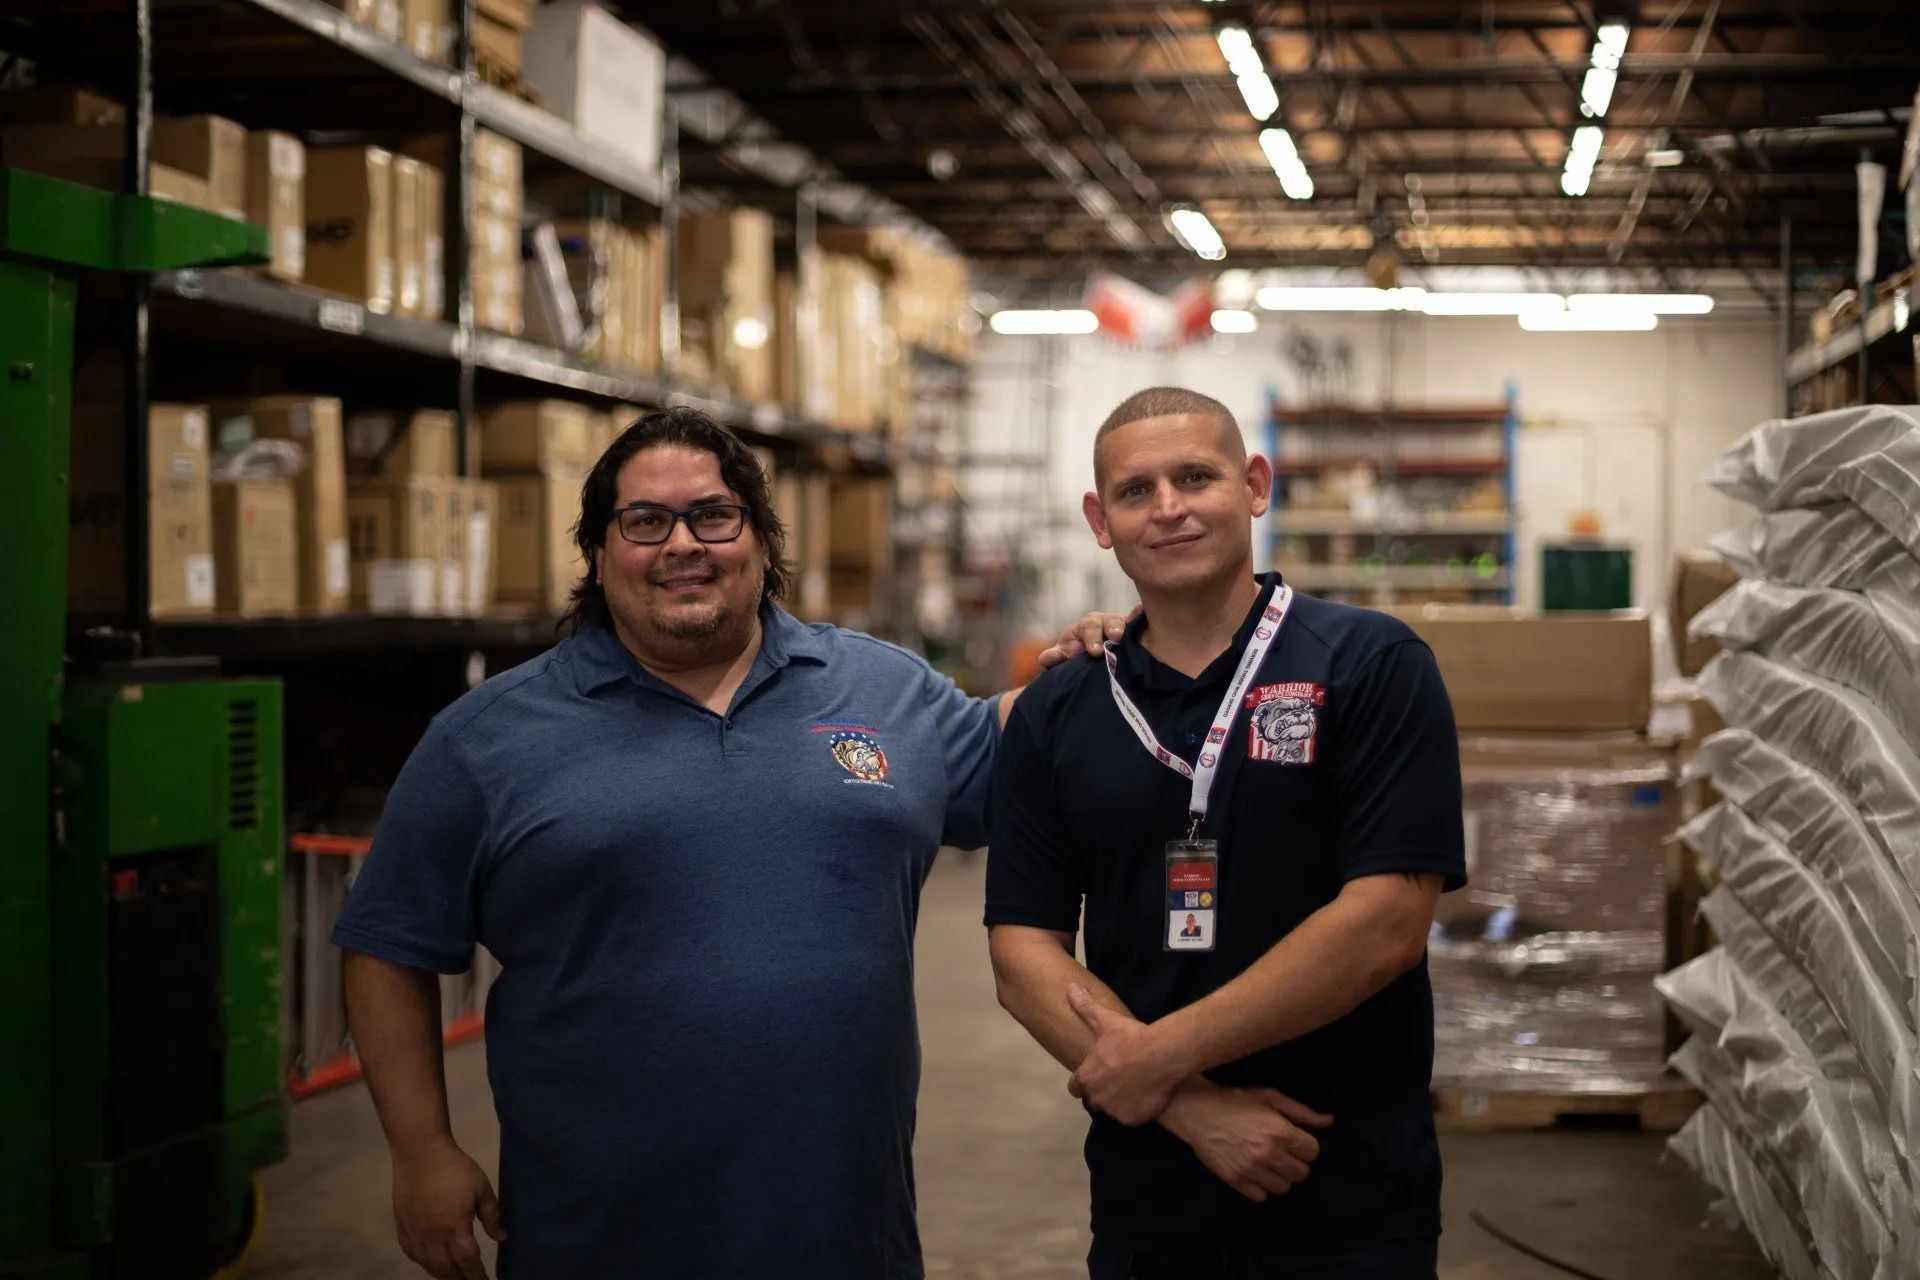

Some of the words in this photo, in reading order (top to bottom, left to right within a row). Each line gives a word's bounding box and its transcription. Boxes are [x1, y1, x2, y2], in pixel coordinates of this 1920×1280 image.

[1246, 648, 1259, 670] SERVING
[1237, 669, 1248, 686] THOSE
[1260, 682, 1313, 695] WARRIOR
[1261, 691, 1284, 700] SERVICE
[1285, 689, 1312, 698] COMPANY
[1223, 698, 1235, 718] SERVED
